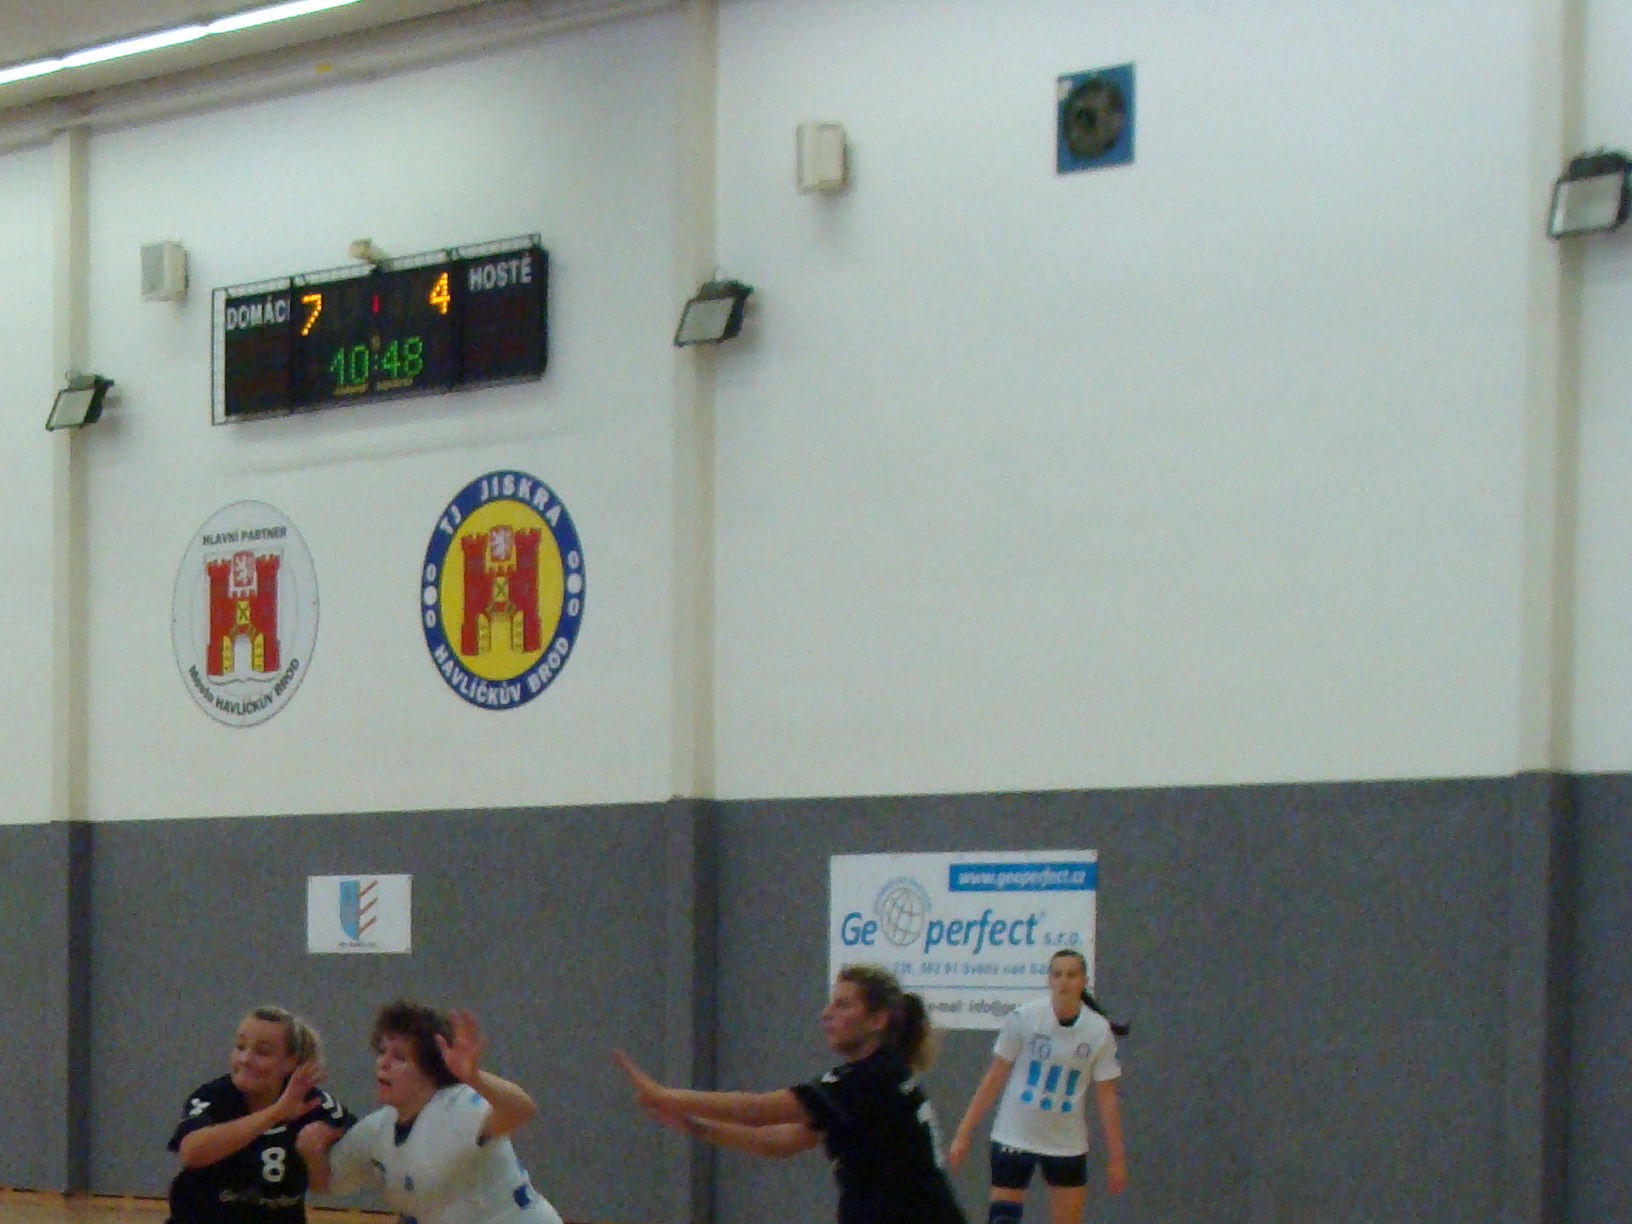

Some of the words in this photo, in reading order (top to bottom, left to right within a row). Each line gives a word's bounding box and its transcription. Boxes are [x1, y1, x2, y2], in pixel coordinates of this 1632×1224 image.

[301, 293, 323, 336] 7
[429, 272, 451, 314] 4
[329, 336, 423, 385] 10:48
[440, 504, 462, 535] TJ
[481, 474, 562, 528] JISKRA
[241, 525, 288, 542] PARTNER
[526, 636, 569, 693] BROD
[261, 1146, 287, 1183] 8
